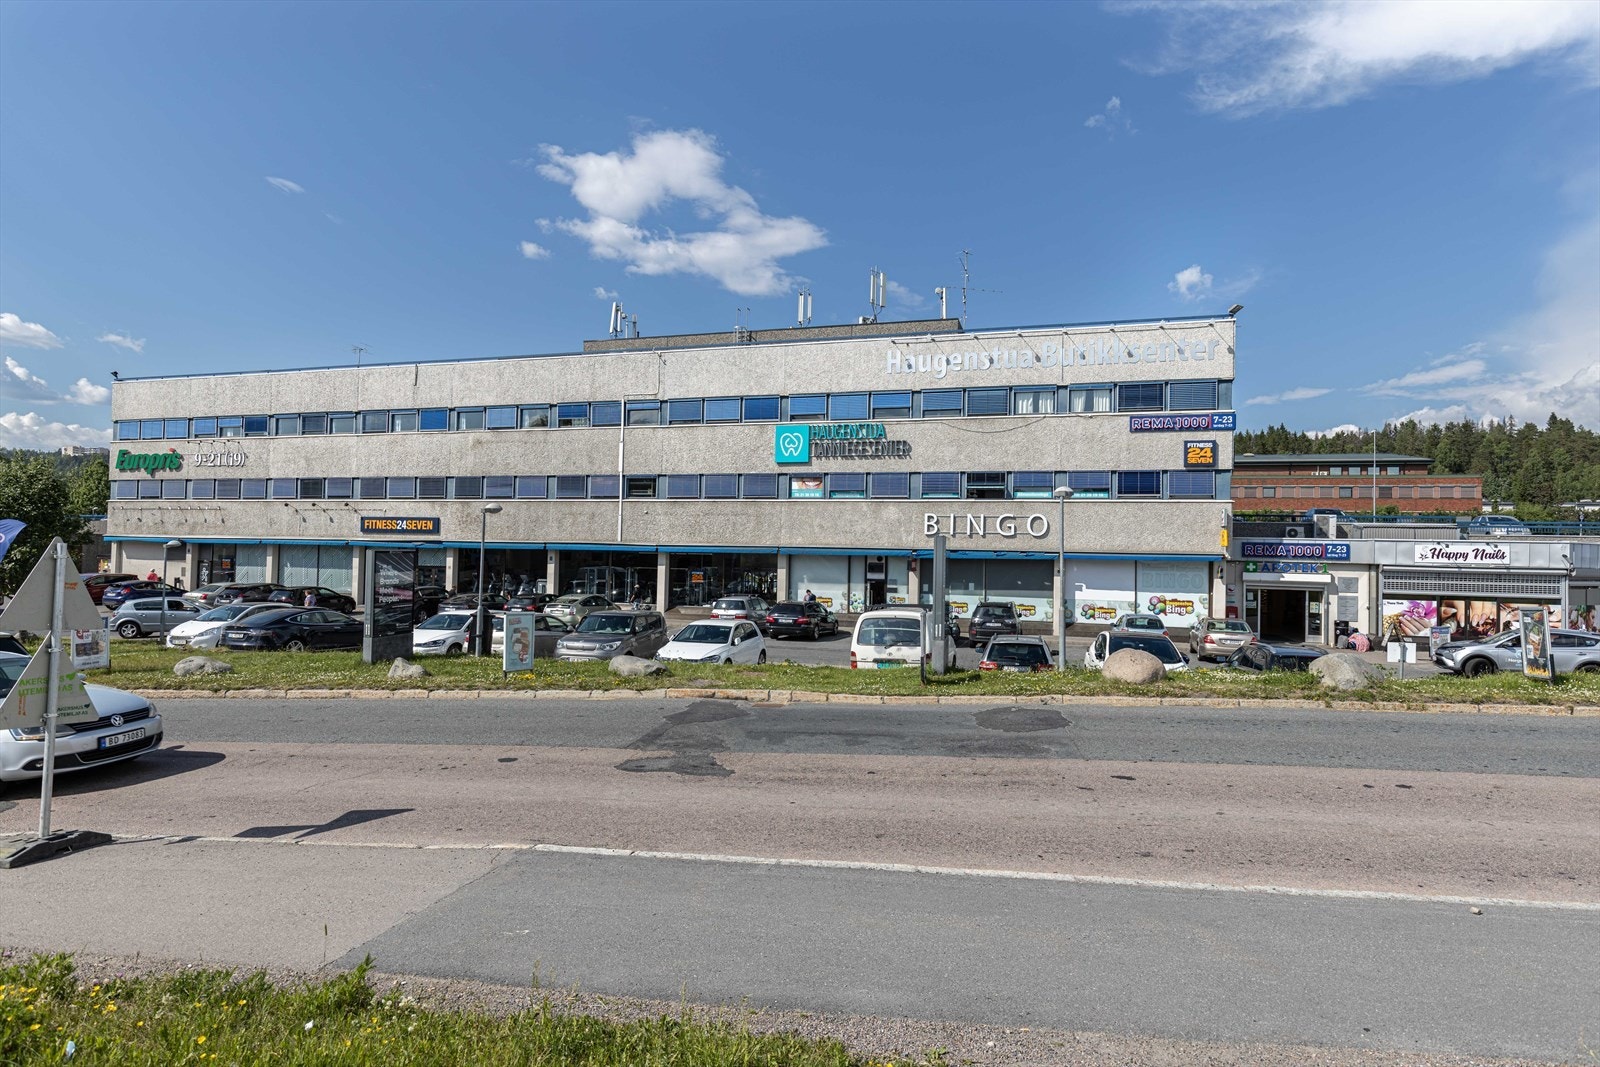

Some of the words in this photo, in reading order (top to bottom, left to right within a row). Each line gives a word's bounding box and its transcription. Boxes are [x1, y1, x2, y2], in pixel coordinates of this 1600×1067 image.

[886, 346, 1033, 379] Haugenstua
[1040, 336, 1220, 368] Butikksenter
[1131, 418, 1173, 429] REMA
[1175, 416, 1208, 428] 1000
[1213, 415, 1233, 423] 7-23
[811, 423, 886, 440] HAUGENSTUA
[810, 440, 911, 458] TANNLEGESENTER
[1187, 447, 1213, 458] 24
[115, 448, 183, 475] Europris
[364, 519, 433, 530] FITNESS24SEVEN
[924, 513, 1048, 537] BINGO
[1244, 544, 1286, 556] REMA
[1289, 545, 1322, 557] 1000
[1327, 545, 1347, 553] 7-23
[1429, 547, 1469, 561] Happy
[1472, 547, 1507, 561] Nails
[1261, 563, 1319, 573] APOTEK
[1321, 563, 1329, 573] 1
[20, 675, 65, 687] AKERSS
[18, 685, 60, 697] UTEMIL
